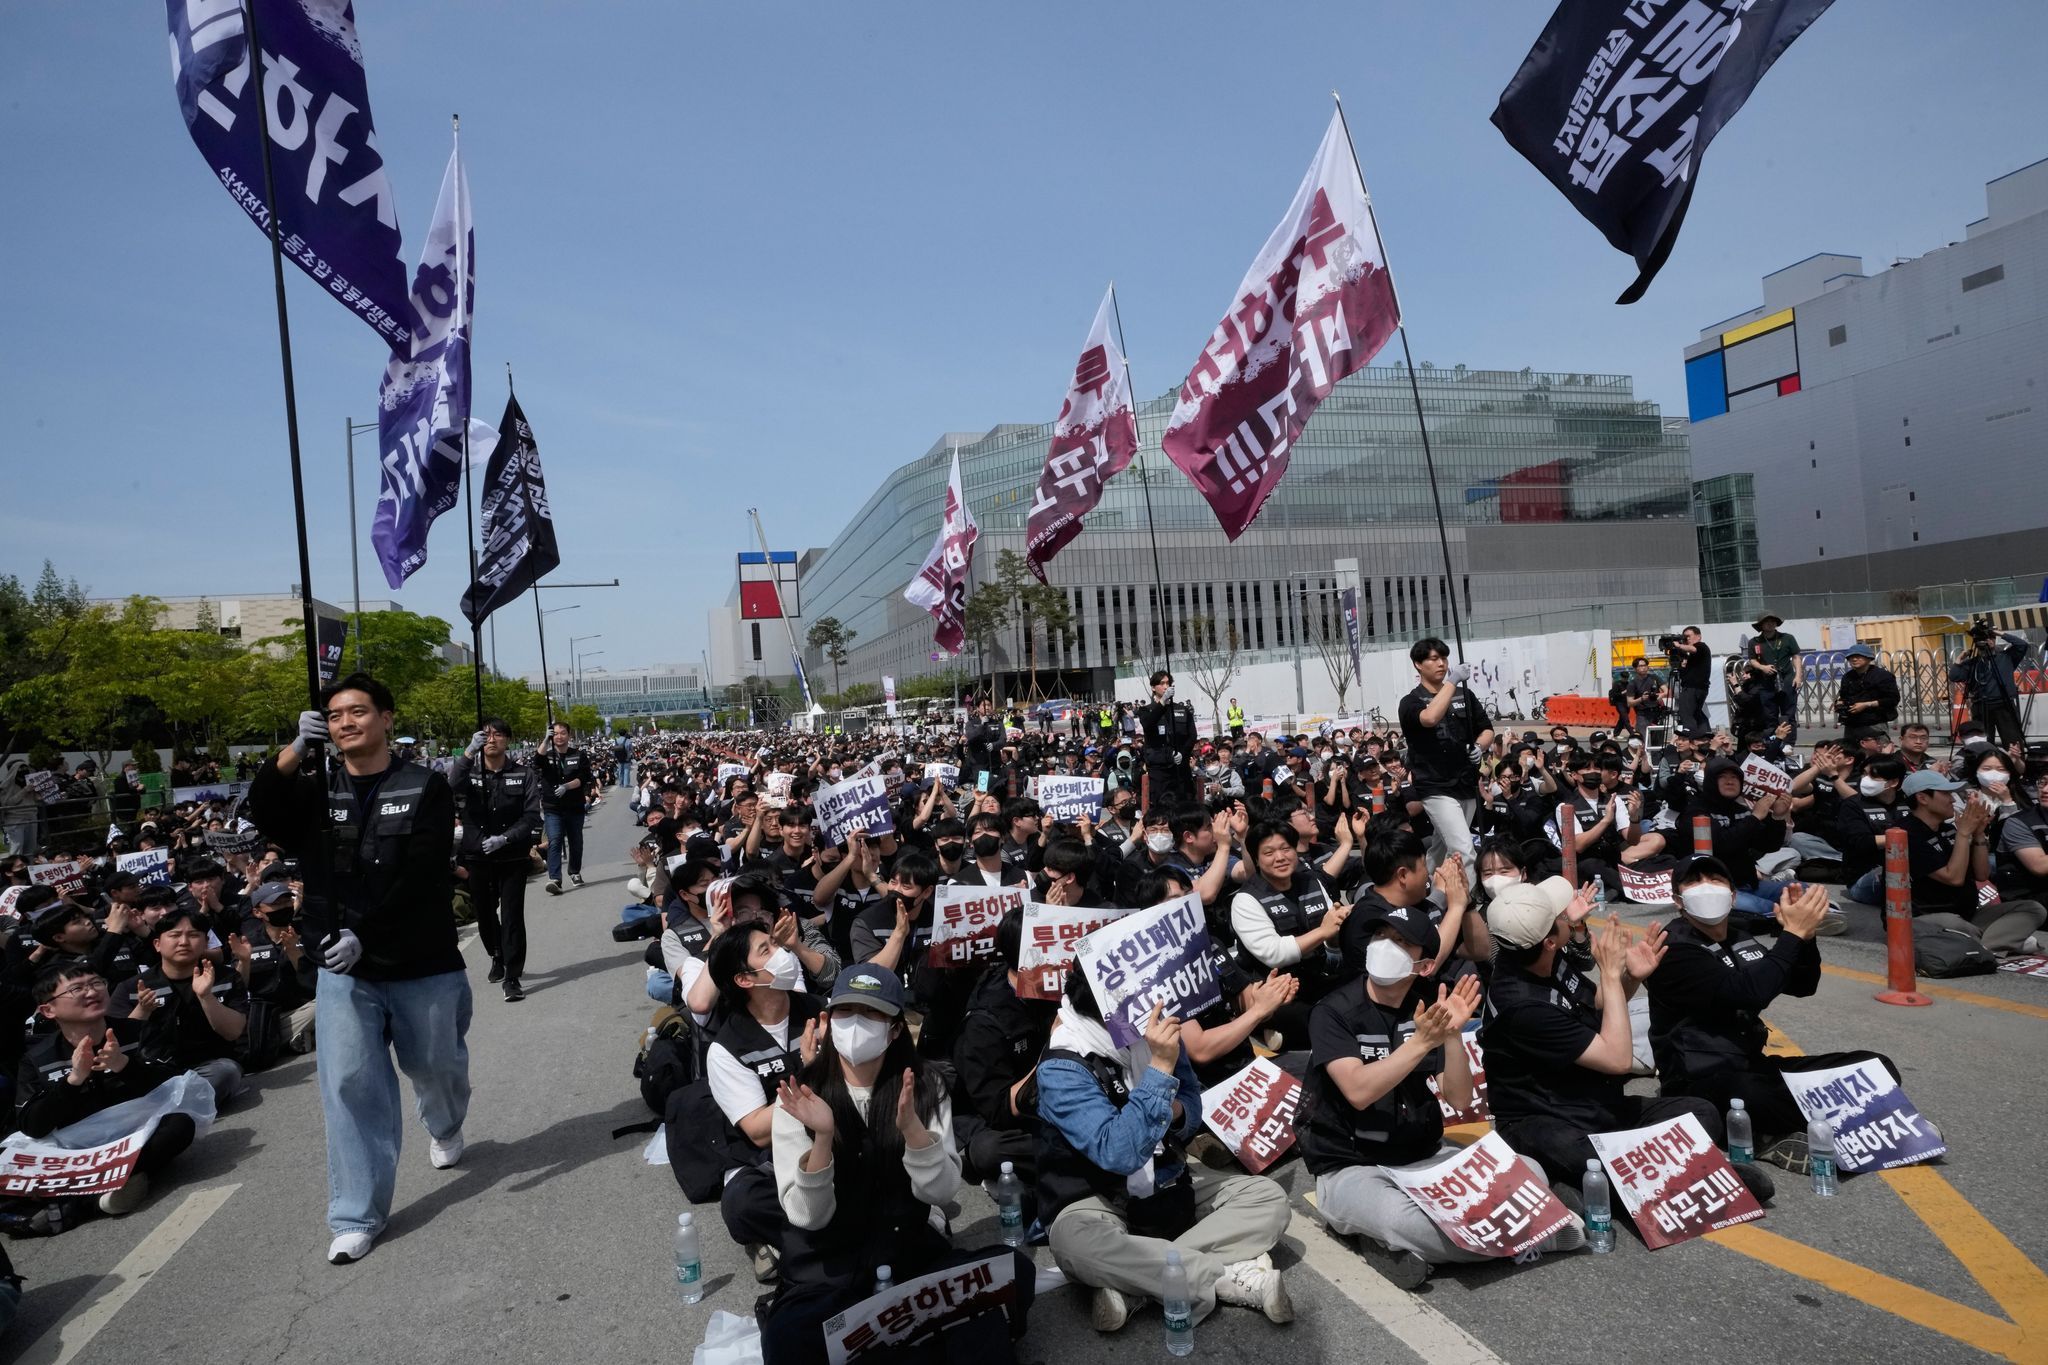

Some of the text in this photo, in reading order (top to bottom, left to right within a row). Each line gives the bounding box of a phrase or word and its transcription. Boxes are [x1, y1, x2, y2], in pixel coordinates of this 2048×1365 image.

[329, 273, 412, 343] 공동투쟁본부
[506, 778, 522, 787] SELU
[885, 775, 905, 787] 하게
[926, 766, 956, 777] 상폐지
[1744, 763, 1792, 789] 투명하게
[1042, 779, 1095, 800] 상한폐지
[379, 803, 411, 816] SELU
[819, 780, 876, 822] 상한폐지
[1047, 801, 1103, 822] 실현하자
[328, 807, 348, 822] 쟁
[831, 804, 891, 846] 실현하자
[34, 864, 75, 882] 투명하게
[138, 867, 168, 889] 하자
[55, 878, 84, 893] 고!!!
[1631, 888, 1674, 901] 명하게
[943, 891, 1025, 929] 투명하게
[1270, 904, 1289, 916] 투쟁
[1305, 903, 1326, 915] SELU
[683, 932, 703, 943] 투쟁
[1096, 900, 1196, 991] 상한폐지
[251, 950, 271, 961] 투쟁
[951, 936, 1004, 963] 바꾸
[1214, 954, 1226, 965] LU
[1744, 950, 1764, 963] SELU
[1127, 949, 1214, 1037] 실현하자
[1359, 1044, 1391, 1061] 투쟁
[757, 1058, 786, 1078] 투쟁
[1210, 1066, 1270, 1133] 투명하게
[1795, 1067, 1878, 1120] 상한폐지
[1834, 1108, 1920, 1170] 실현하자
[11, 1137, 132, 1171] 투명하게
[1609, 1122, 1697, 1190] 투명하게
[5, 1164, 128, 1194] 바꾸고!!!
[1404, 1145, 1501, 1212] 투명하게
[1651, 1166, 1744, 1233] 바꾸고!!!
[1452, 1178, 1551, 1249] 바꾸고!!!
[1512, 1230, 1548, 1253] 삼성전자노동조합
[841, 1262, 993, 1362] 투명하게
